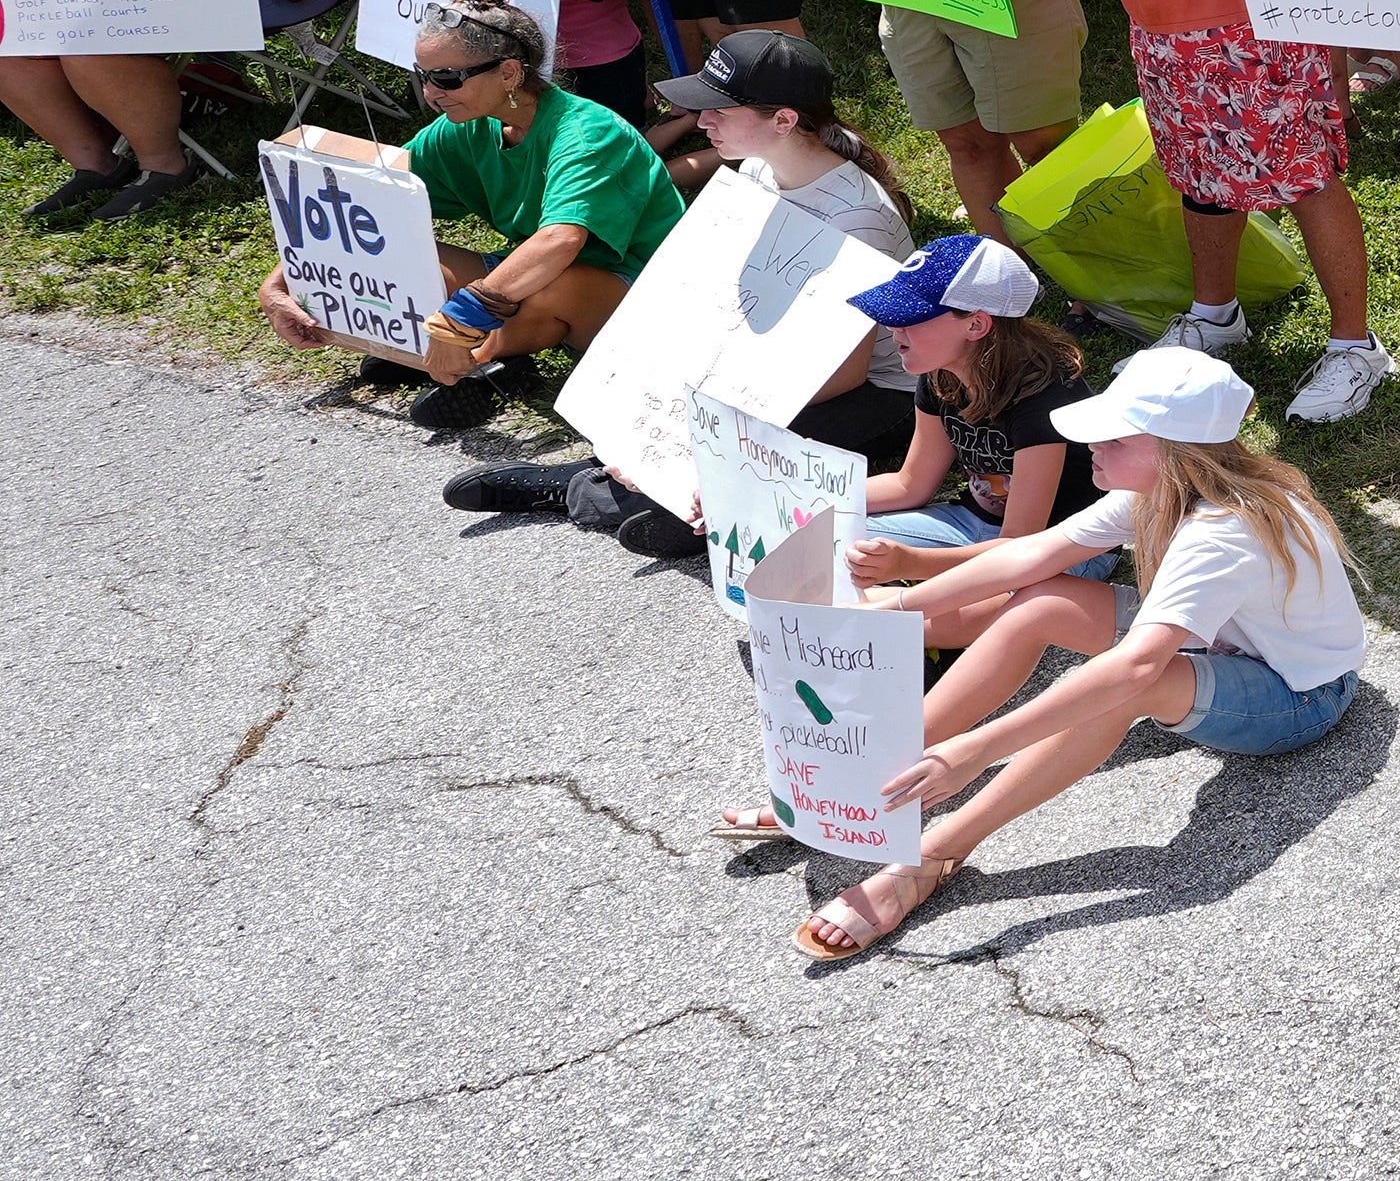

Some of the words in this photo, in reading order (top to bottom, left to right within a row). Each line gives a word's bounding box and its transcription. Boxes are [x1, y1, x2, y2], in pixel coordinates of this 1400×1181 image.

[102, 5, 148, 18] courts
[259, 153, 386, 256] Vote
[284, 245, 342, 290] Save
[349, 271, 399, 304] our
[311, 289, 426, 356] Planet
[691, 390, 721, 440] Save
[734, 411, 800, 478] Honeymoon
[773, 744, 821, 786] SAVE
[778, 723, 868, 758] pickleball!
[792, 782, 879, 822] HONEYMOON
